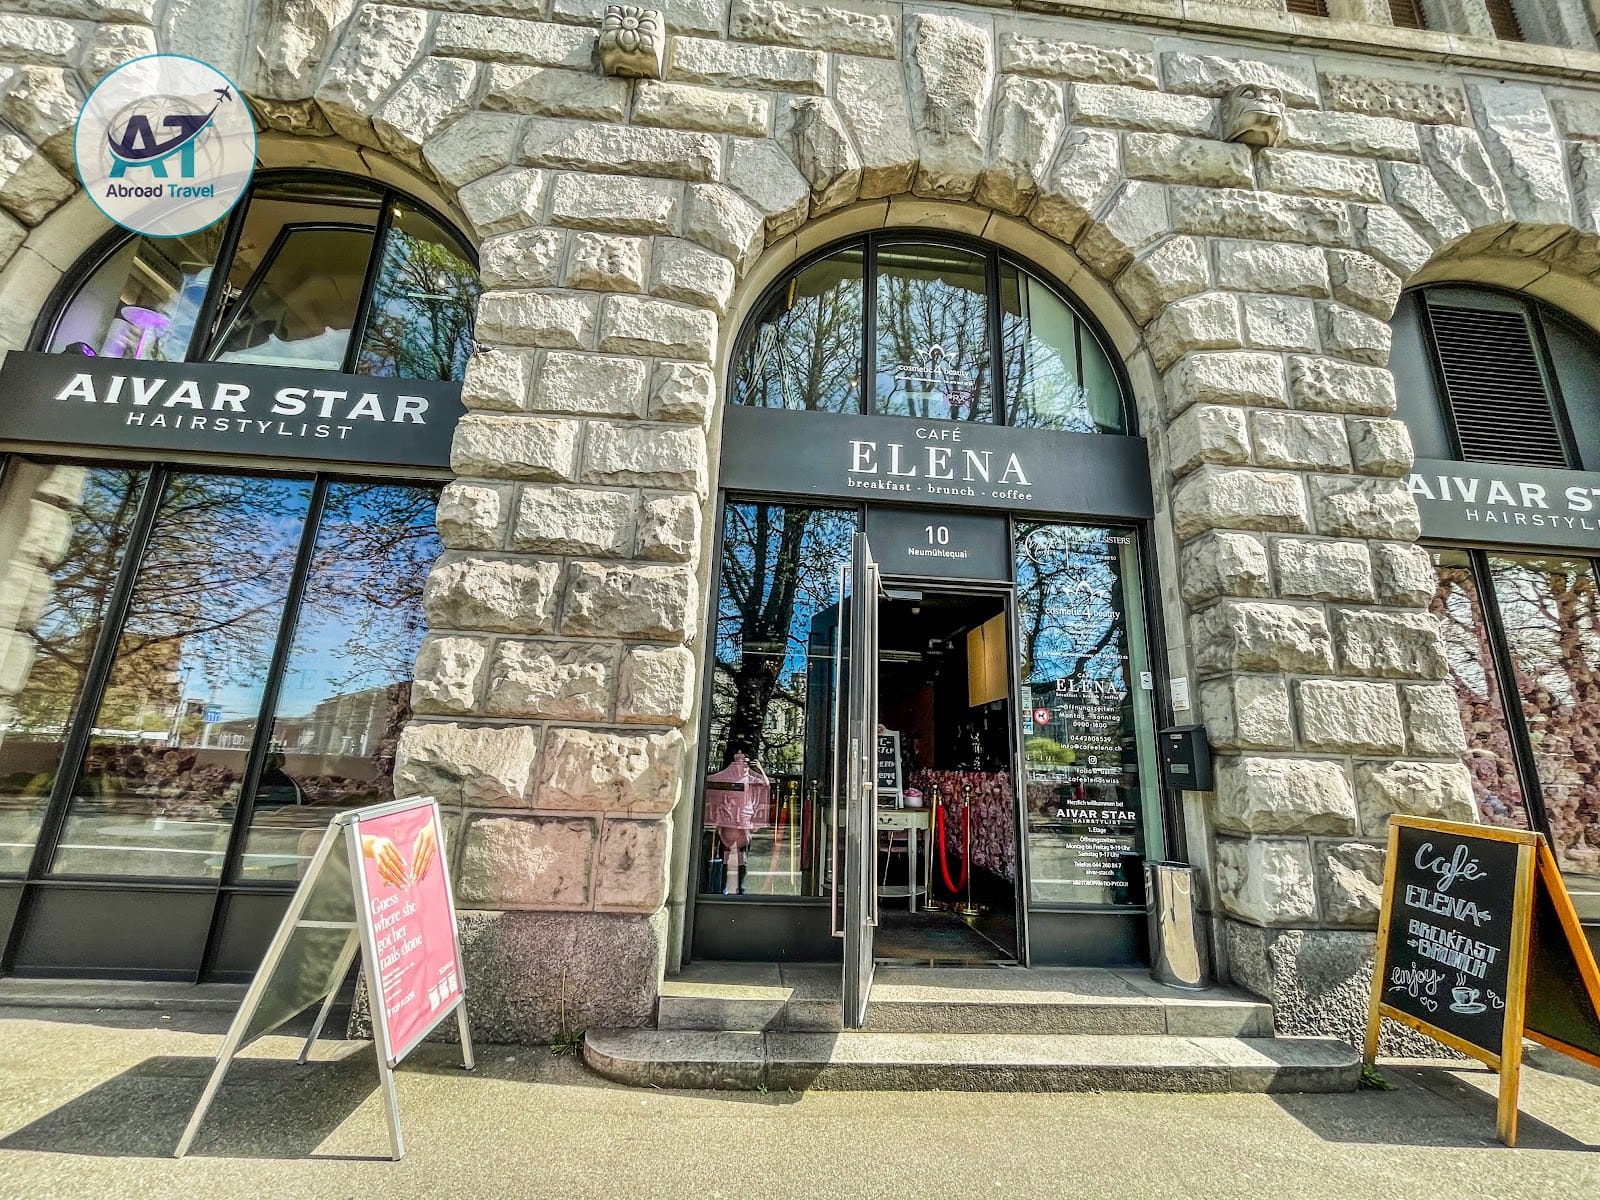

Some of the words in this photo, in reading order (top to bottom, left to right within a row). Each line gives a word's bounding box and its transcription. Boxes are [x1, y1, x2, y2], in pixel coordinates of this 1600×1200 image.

[934, 364, 942, 376] 4
[55, 372, 251, 413] AIVAR
[270, 387, 430, 426] STAR
[126, 411, 354, 440] HAIRSTYLIST
[915, 426, 961, 442] CAFÉ
[847, 440, 1032, 486] ELENA
[847, 477, 911, 492] breakfast
[927, 483, 975, 497] brunch
[992, 489, 1033, 501] coffee
[1408, 473, 1550, 510] AIVAR
[925, 525, 949, 545] 10
[1103, 536, 1130, 545] SISTERS
[908, 547, 968, 559] Neumühlequai
[1056, 678, 1118, 694] ELENA
[1059, 712, 1085, 720] Montag
[1056, 808, 1098, 819] AIVAR
[1101, 810, 1136, 820] STAR
[1414, 842, 1488, 892] Café
[371, 894, 399, 915] Guess
[374, 911, 401, 933] where
[402, 900, 417, 917] she
[1404, 884, 1480, 927] ELENA
[377, 934, 392, 956] got
[391, 925, 408, 942] her
[380, 945, 401, 971] nails
[401, 934, 423, 955] done
[1408, 918, 1501, 964] BREAKFAST
[1418, 938, 1488, 979] BRUNCH
[1390, 961, 1446, 998] enjoy
